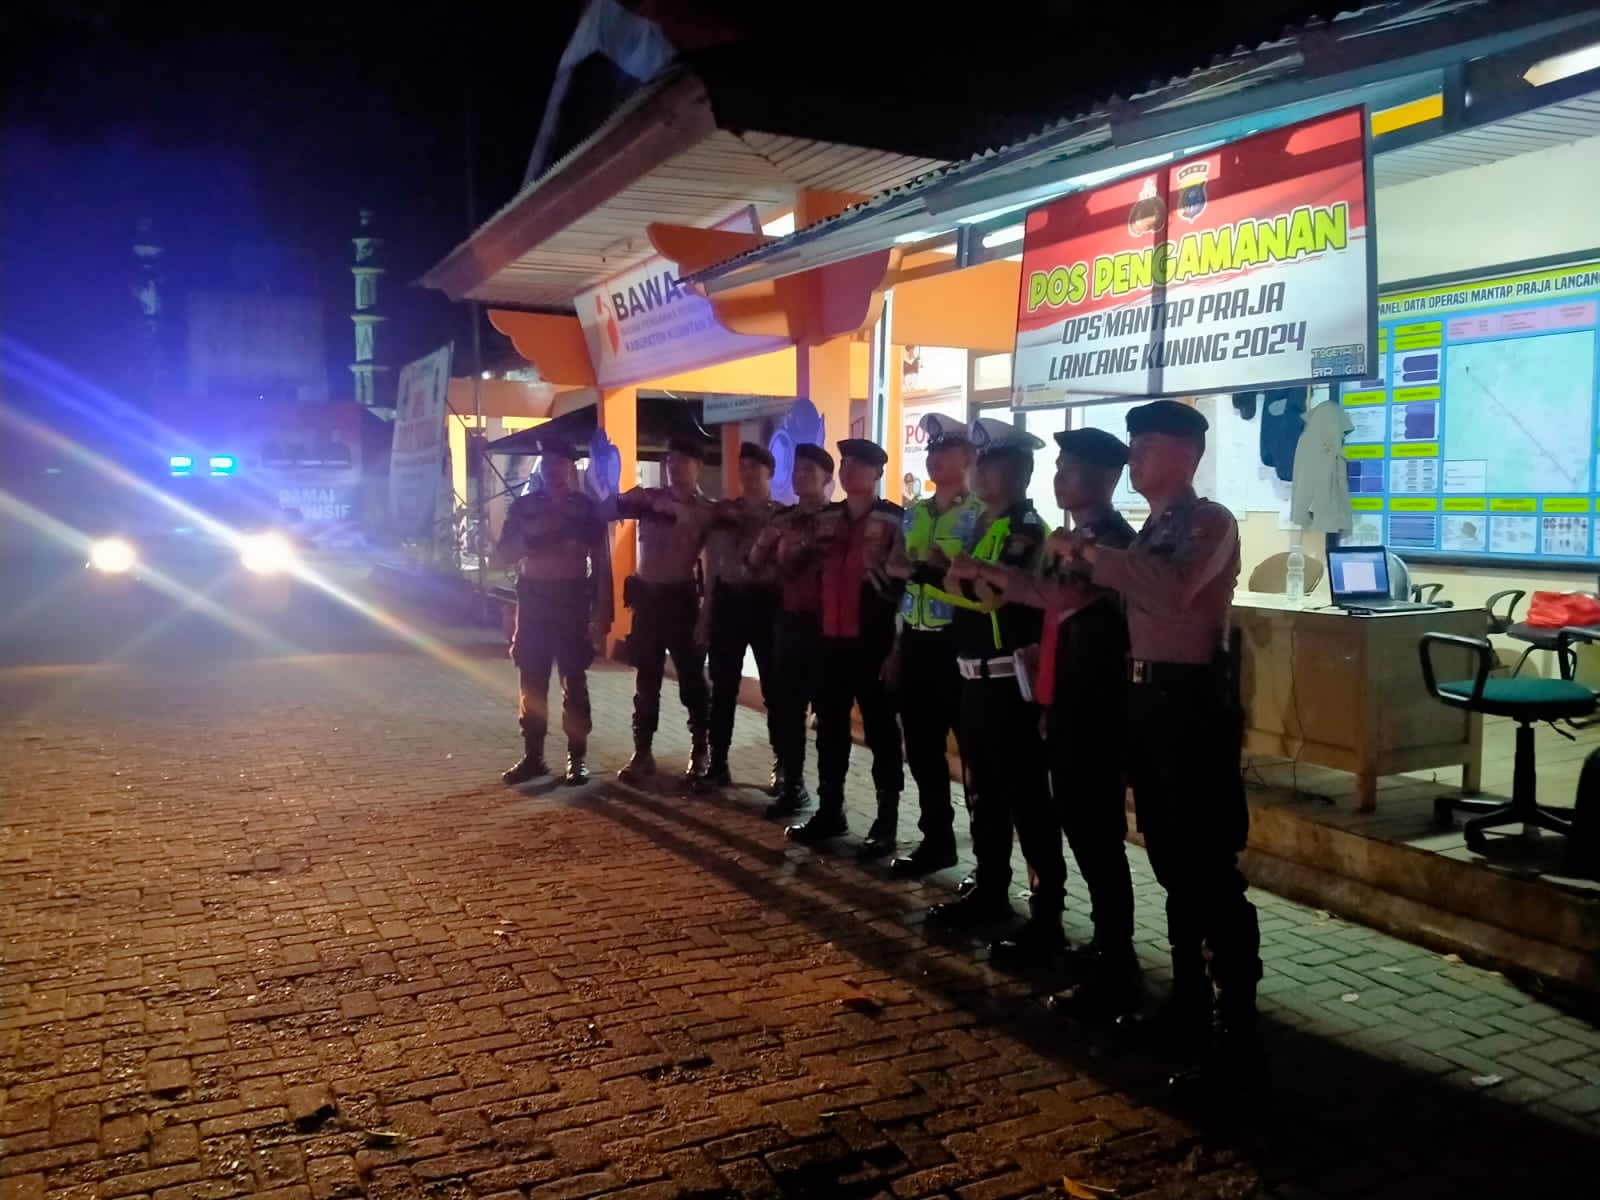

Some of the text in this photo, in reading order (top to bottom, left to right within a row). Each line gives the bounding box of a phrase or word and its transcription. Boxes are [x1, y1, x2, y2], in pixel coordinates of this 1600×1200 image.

[1029, 203, 1348, 310] POS PENGAMANAN
[612, 270, 688, 320] BAWA
[1062, 281, 1286, 345] OPS MANTAP PRAJA
[1378, 271, 1600, 316] ANEL DATA OPERASI MANTAP PRAJA LANCAN
[1048, 320, 1307, 381] LANCANG KUNING 2024
[905, 425, 929, 444] PO
